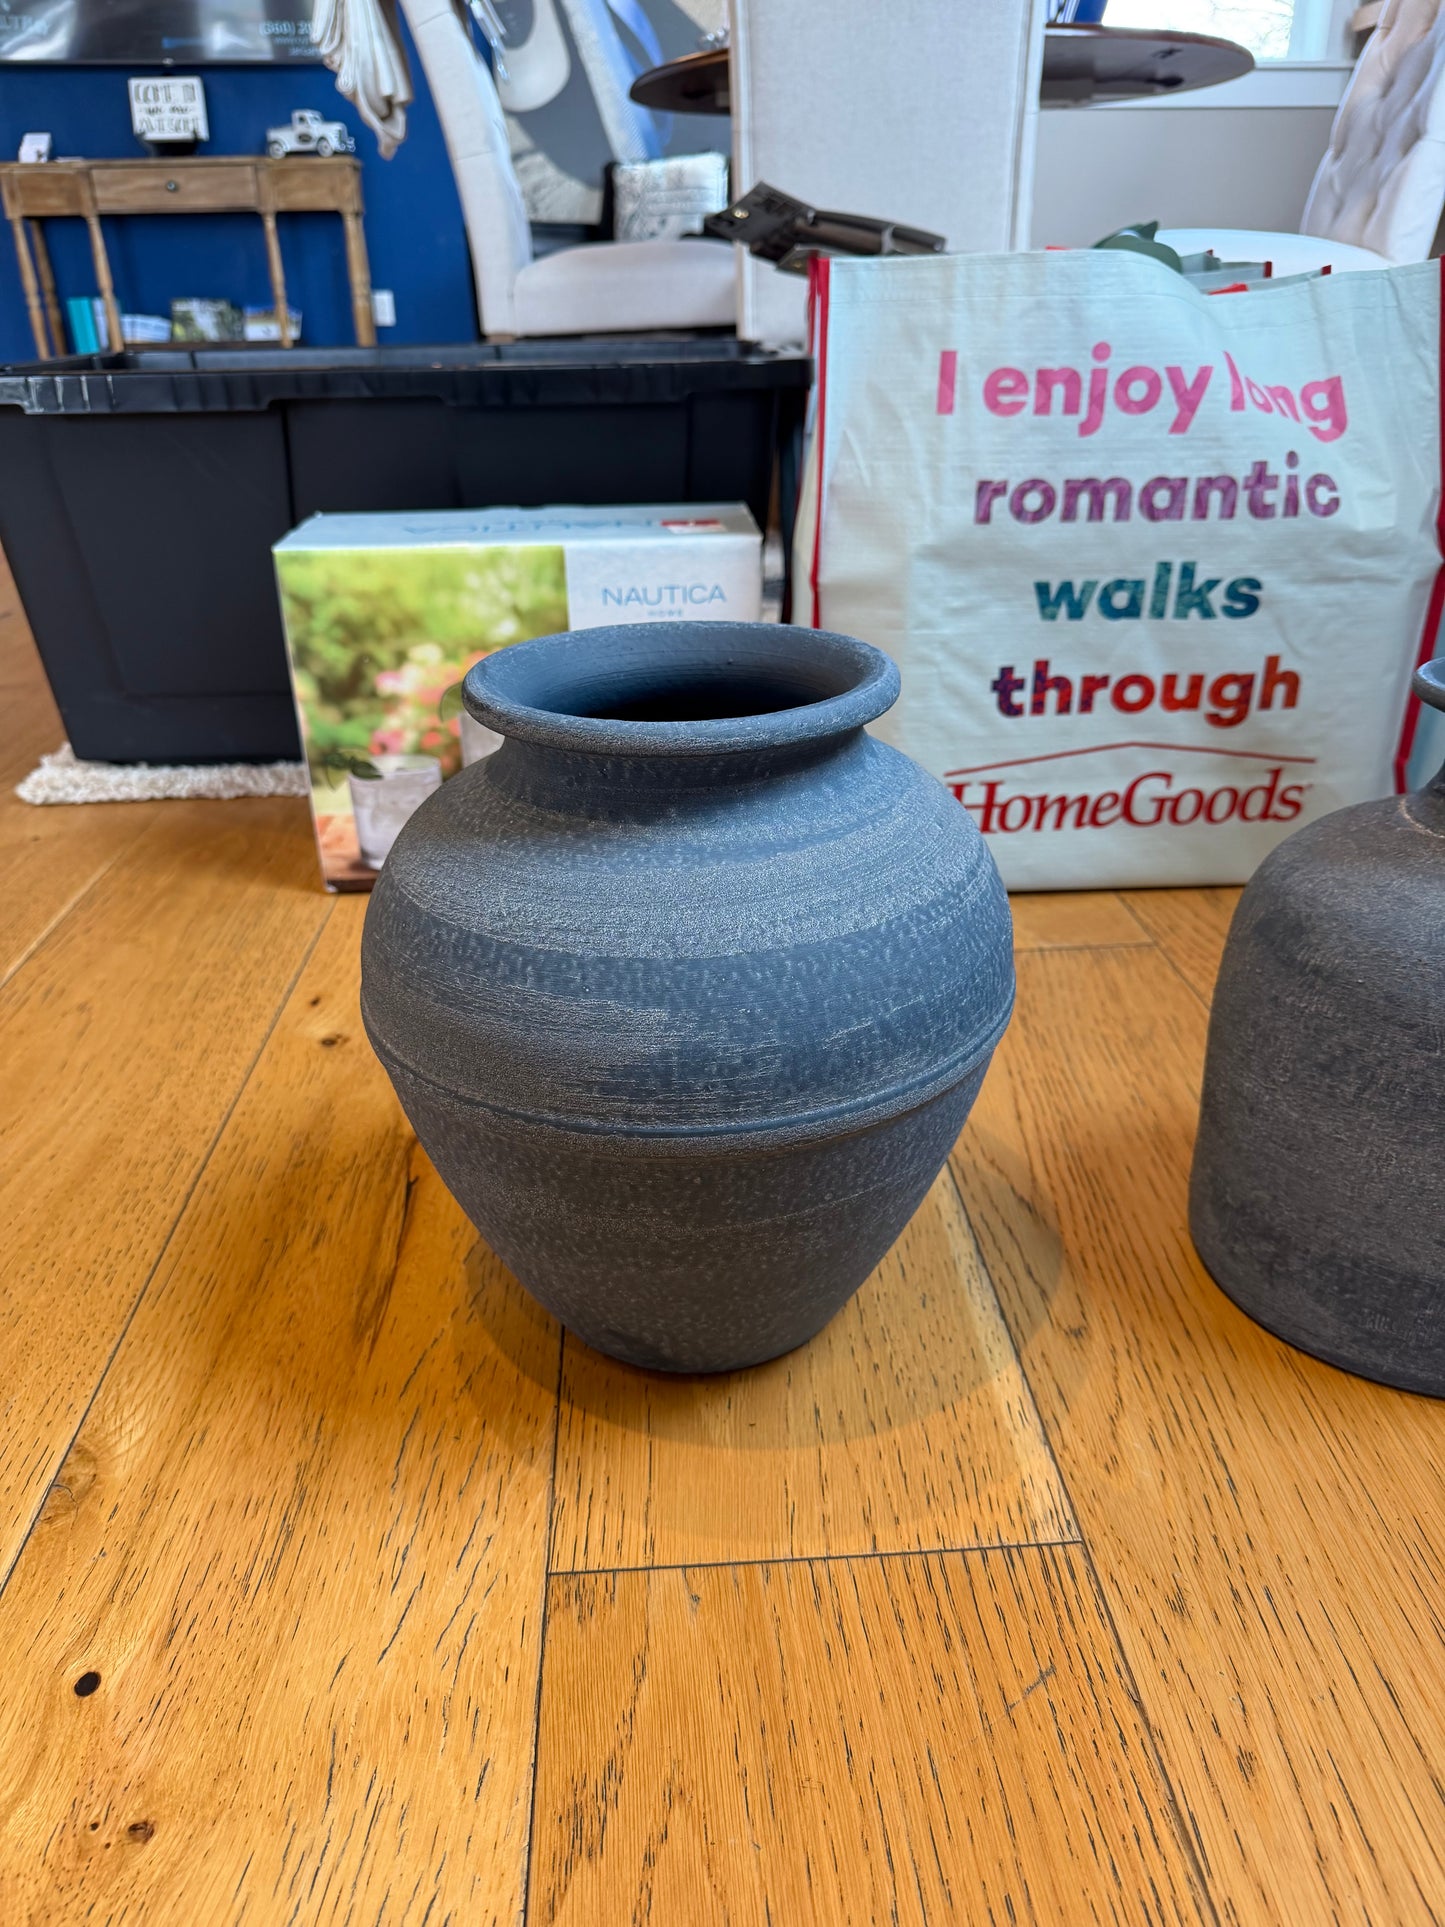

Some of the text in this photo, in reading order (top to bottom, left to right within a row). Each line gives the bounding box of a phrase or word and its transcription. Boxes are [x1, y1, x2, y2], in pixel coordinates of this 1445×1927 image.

[936, 342, 1348, 443] I enjoy long
[974, 450, 1341, 526] romantic
[601, 583, 728, 606] NAUTICA
[1034, 561, 1263, 621] walks
[991, 654, 1300, 728] through
[946, 766, 1304, 834] HomeGoods
